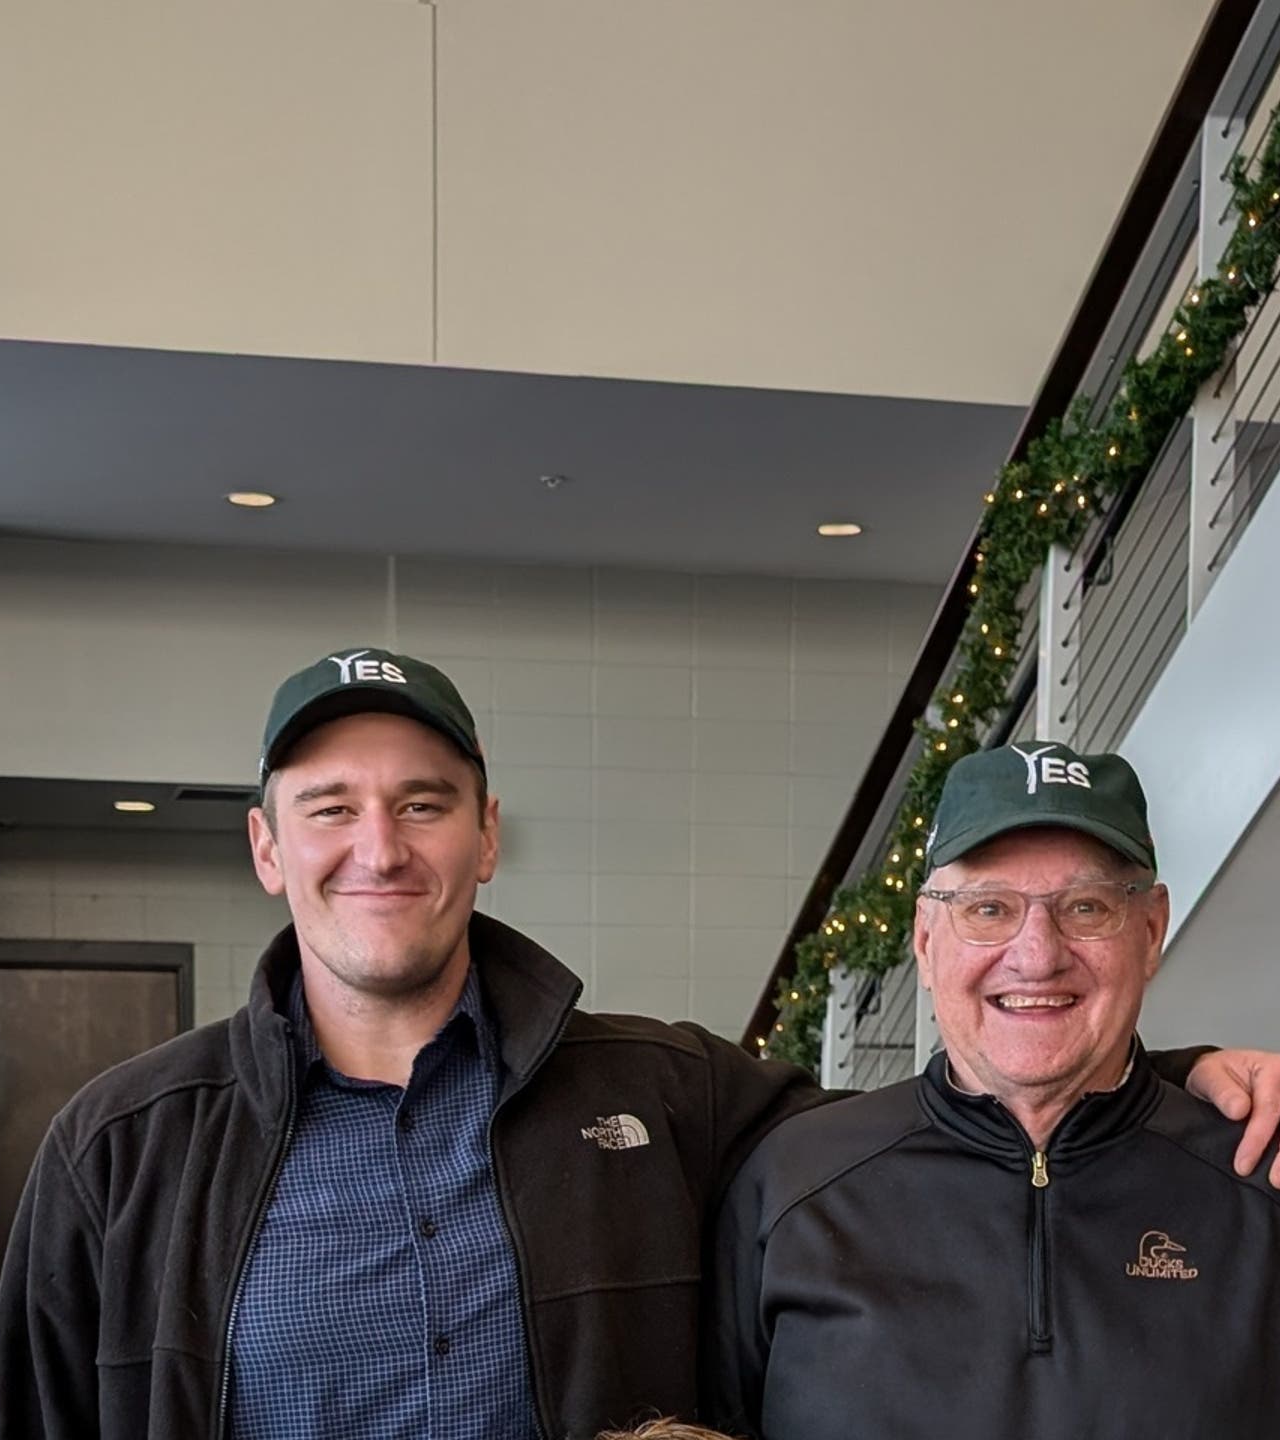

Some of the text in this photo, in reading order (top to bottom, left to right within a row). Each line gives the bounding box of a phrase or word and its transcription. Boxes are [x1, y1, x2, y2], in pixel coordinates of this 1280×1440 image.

[328, 650, 407, 684] YES
[1010, 744, 1092, 795] YES
[596, 1115, 620, 1128] THE
[581, 1126, 623, 1139] NORTH
[597, 1137, 626, 1150] FACE
[1139, 1256, 1184, 1270] DUCKS
[1125, 1262, 1199, 1280] UNLIMITED
